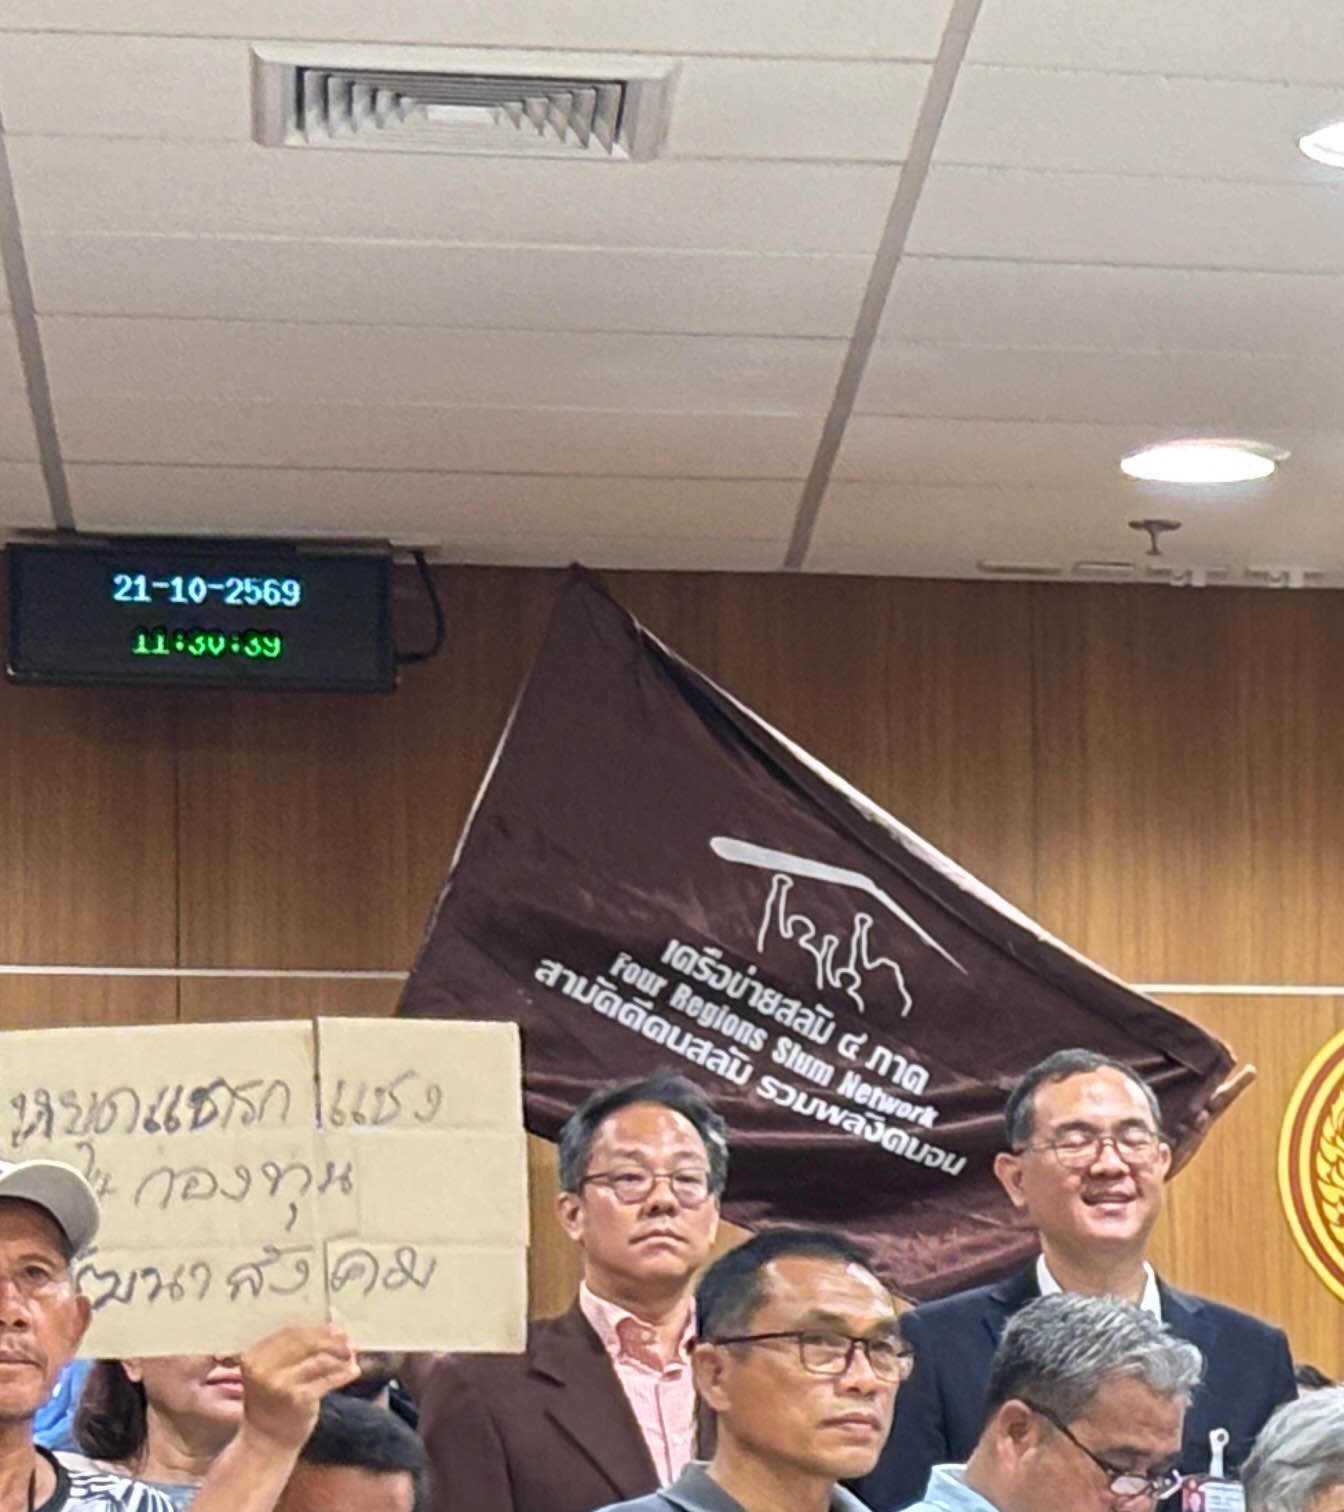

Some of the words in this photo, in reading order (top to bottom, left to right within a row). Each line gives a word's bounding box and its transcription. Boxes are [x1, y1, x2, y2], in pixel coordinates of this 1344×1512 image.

[113, 574, 301, 607] 21-10-2569
[610, 953, 663, 998] Four
[669, 983, 767, 1052] Regions
[770, 1038, 835, 1090] Slum
[836, 1067, 940, 1128] Network
[662, 939, 834, 1047] เครือข่ายสลัม
[867, 1043, 931, 1095] ภาค
[755, 1072, 968, 1178] รวมพลังคนจน
